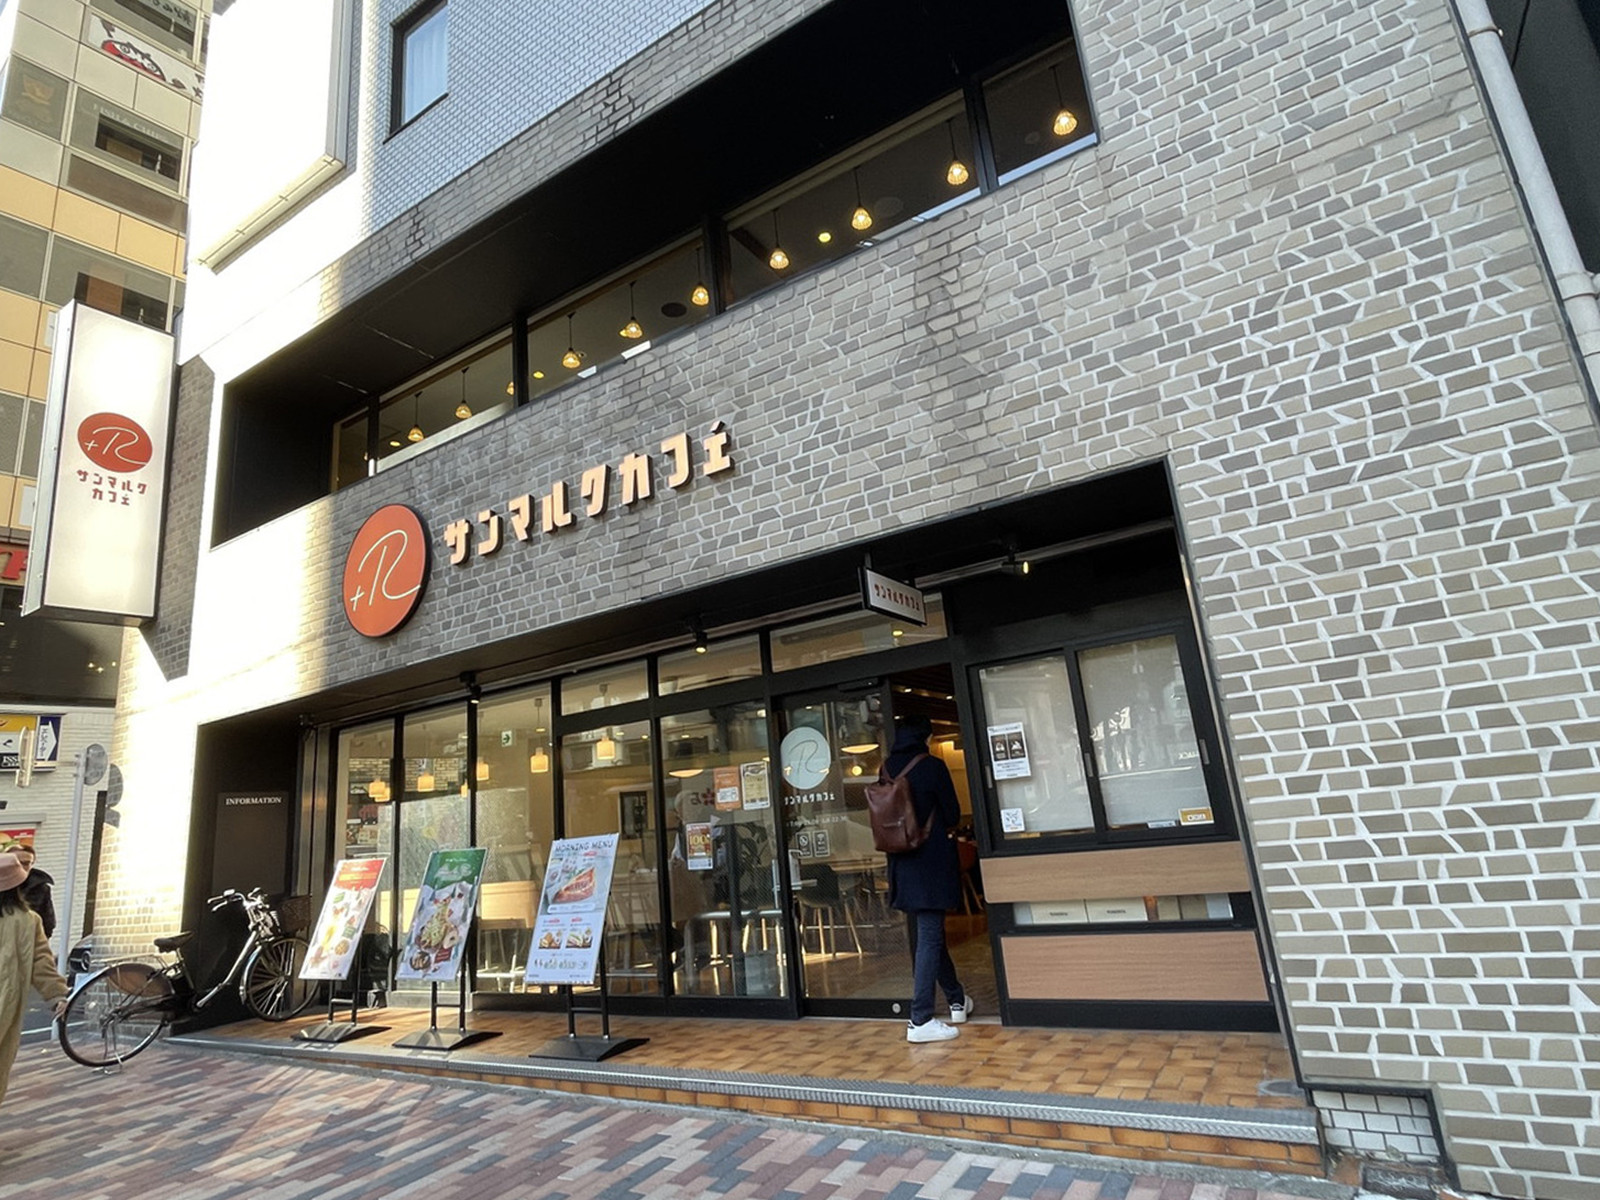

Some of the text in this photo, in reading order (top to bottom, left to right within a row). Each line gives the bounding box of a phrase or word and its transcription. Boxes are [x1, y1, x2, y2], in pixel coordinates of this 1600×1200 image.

[76, 468, 148, 496] サンマルク
[442, 420, 735, 567] サンマルクカフェ
[92, 487, 131, 506] カフェ
[225, 796, 282, 806] INFORMATION
